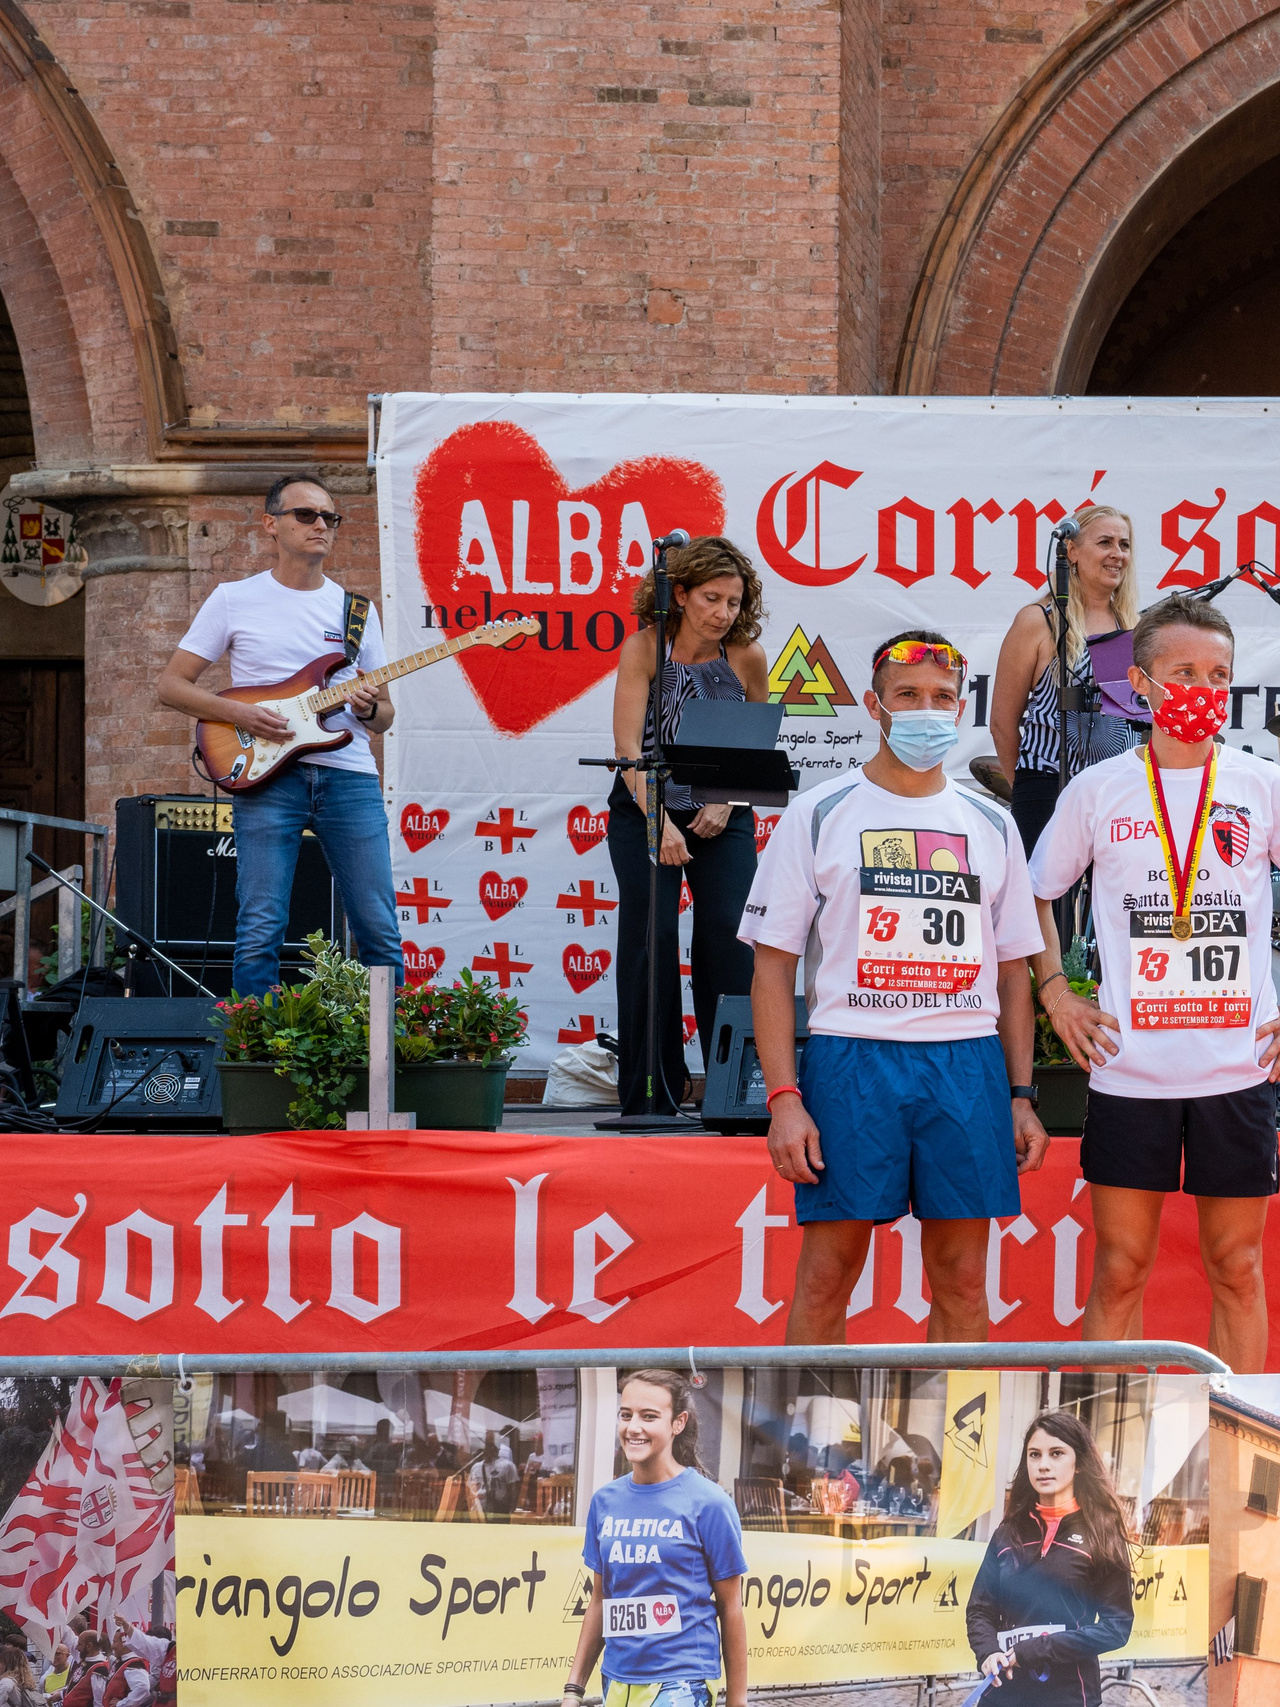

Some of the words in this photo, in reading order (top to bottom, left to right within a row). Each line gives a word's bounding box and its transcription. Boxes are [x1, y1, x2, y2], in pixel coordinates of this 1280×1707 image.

[756, 460, 1107, 590] Corr
[453, 498, 656, 596] ALBA
[823, 730, 863, 749] Sport
[788, 757, 843, 769] onferrato
[406, 815, 440, 832] ALBA
[1110, 820, 1160, 843] IDEA
[1111, 816, 1132, 825] rivista
[874, 871, 912, 886] rivista
[914, 873, 970, 899] IDEA
[1147, 868, 1211, 882] BOO
[485, 883, 519, 900] ALBA
[1122, 889, 1170, 911] Santa
[1189, 889, 1242, 907] osalia
[866, 905, 900, 942] 13
[922, 907, 966, 947] 30
[1143, 913, 1174, 927] rivist
[1190, 912, 1238, 933] DEA
[568, 955, 602, 973] ALBA
[862, 961, 895, 975] Corri
[901, 965, 931, 977] sotto
[937, 965, 947, 978] le
[953, 967, 977, 979] torri
[1137, 947, 1170, 982] 13
[1185, 945, 1241, 982] 167
[888, 979, 895, 987] 12
[896, 979, 938, 989] SETTEMBRE
[938, 981, 954, 990] 2021
[847, 993, 908, 1009] BORGO
[912, 993, 942, 1009] DEL
[945, 993, 982, 1009] FUMO
[1136, 1001, 1168, 1013] Corri
[1174, 1001, 1203, 1012] sotto
[1208, 1000, 1218, 1012] le
[1224, 1001, 1249, 1012] torri
[1162, 1016, 1169, 1024] 12
[1170, 1016, 1210, 1025] SETTEMBRE
[1210, 1015, 1225, 1024] 2021
[0, 1181, 404, 1325] sotto
[505, 1172, 636, 1326] le
[735, 1177, 1087, 1327] trri
[601, 1515, 684, 1540] ATLETICA
[608, 1540, 662, 1564] ALBA
[846, 1556, 932, 1626] Sport
[1131, 1560, 1165, 1602] ort
[176, 1553, 380, 1657] riangolo
[409, 1551, 546, 1641] Sport
[610, 1602, 647, 1632] 6256
[766, 1645, 797, 1658] ROERO
[797, 1642, 859, 1656] ASSOCIAZIONE
[860, 1640, 898, 1652] SPORTIVA
[898, 1637, 956, 1650] DILETTANTISTICA
[176, 1665, 278, 1683] MONFERRATO
[281, 1665, 328, 1680] ROERO
[330, 1661, 433, 1678] ASSOCIAZIONE
[436, 1658, 499, 1674] SPORTIVA
[502, 1655, 575, 1672] DILETTANTIS
